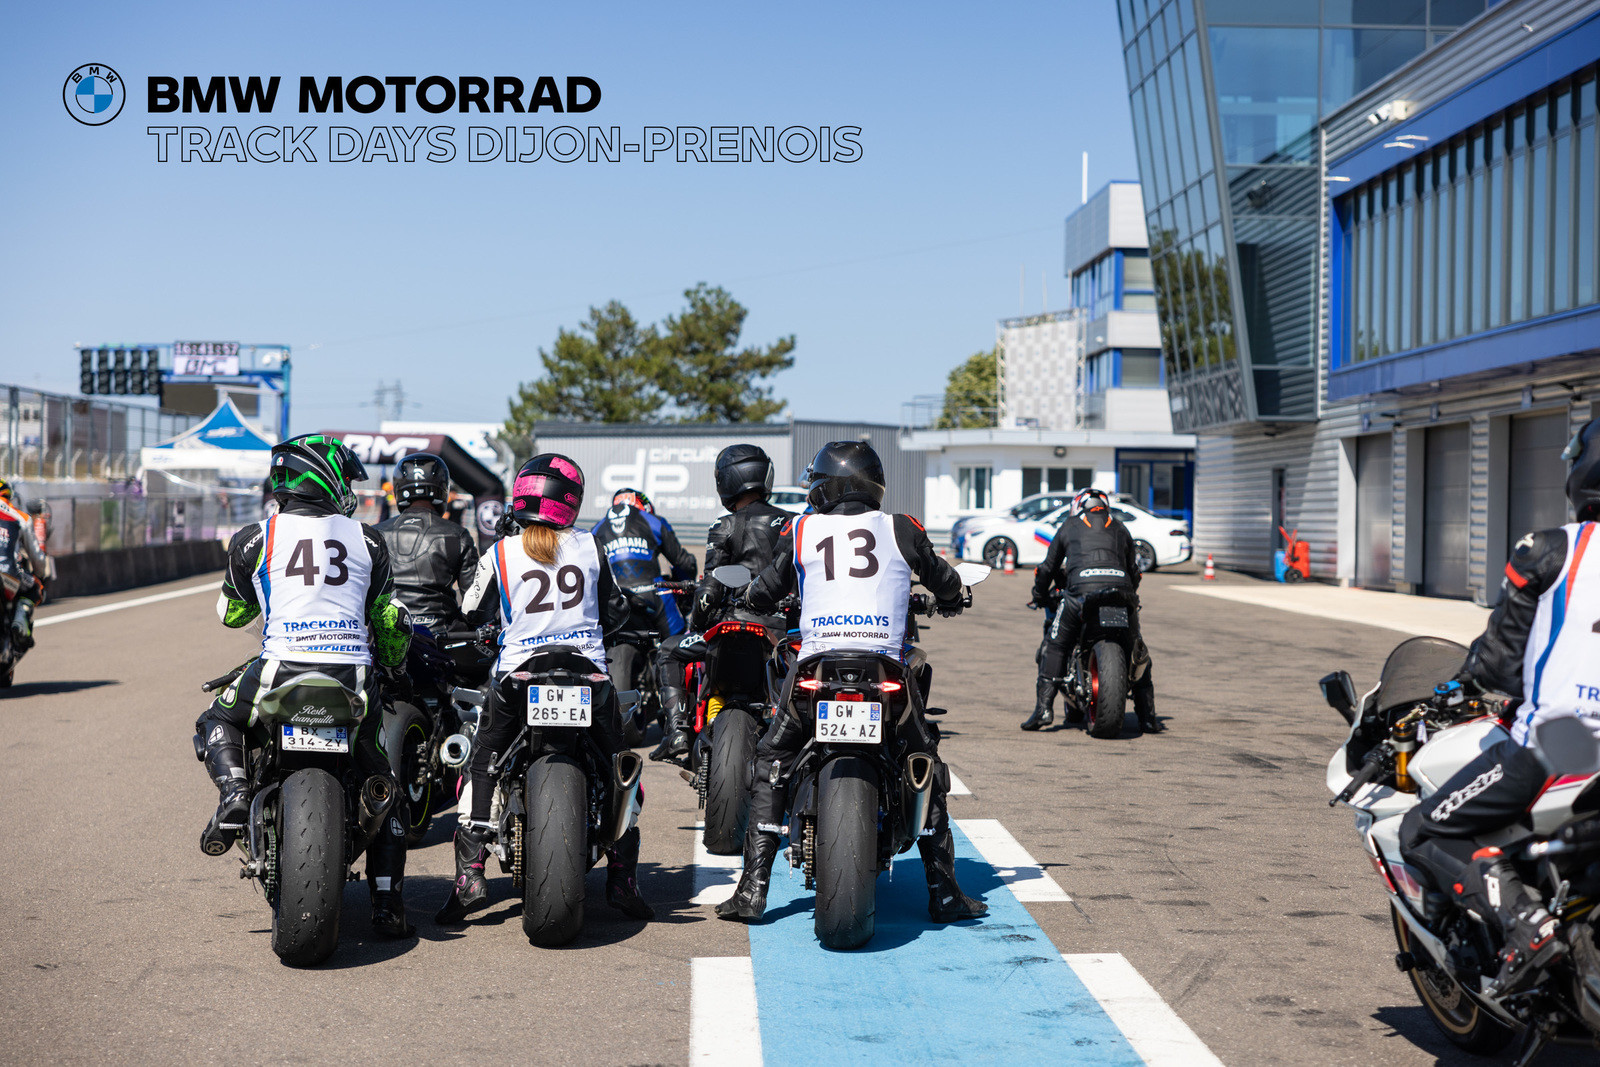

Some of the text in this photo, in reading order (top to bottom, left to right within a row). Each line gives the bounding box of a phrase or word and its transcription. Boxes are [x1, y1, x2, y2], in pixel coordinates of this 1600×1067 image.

[606, 536, 648, 552] YAMAHA
[815, 528, 879, 582] 13
[285, 538, 349, 586] 43
[521, 564, 585, 614] 29
[283, 619, 359, 632] TRACKDAYS
[811, 614, 889, 628] TRACKDAYS
[319, 633, 360, 641] MOTORRAD
[843, 631, 890, 639] MOTORRAD
[547, 689, 563, 702] GW
[299, 704, 327, 716] Reste
[836, 705, 853, 718] GW
[291, 713, 334, 726] tranquille
[301, 726, 318, 736] BX
